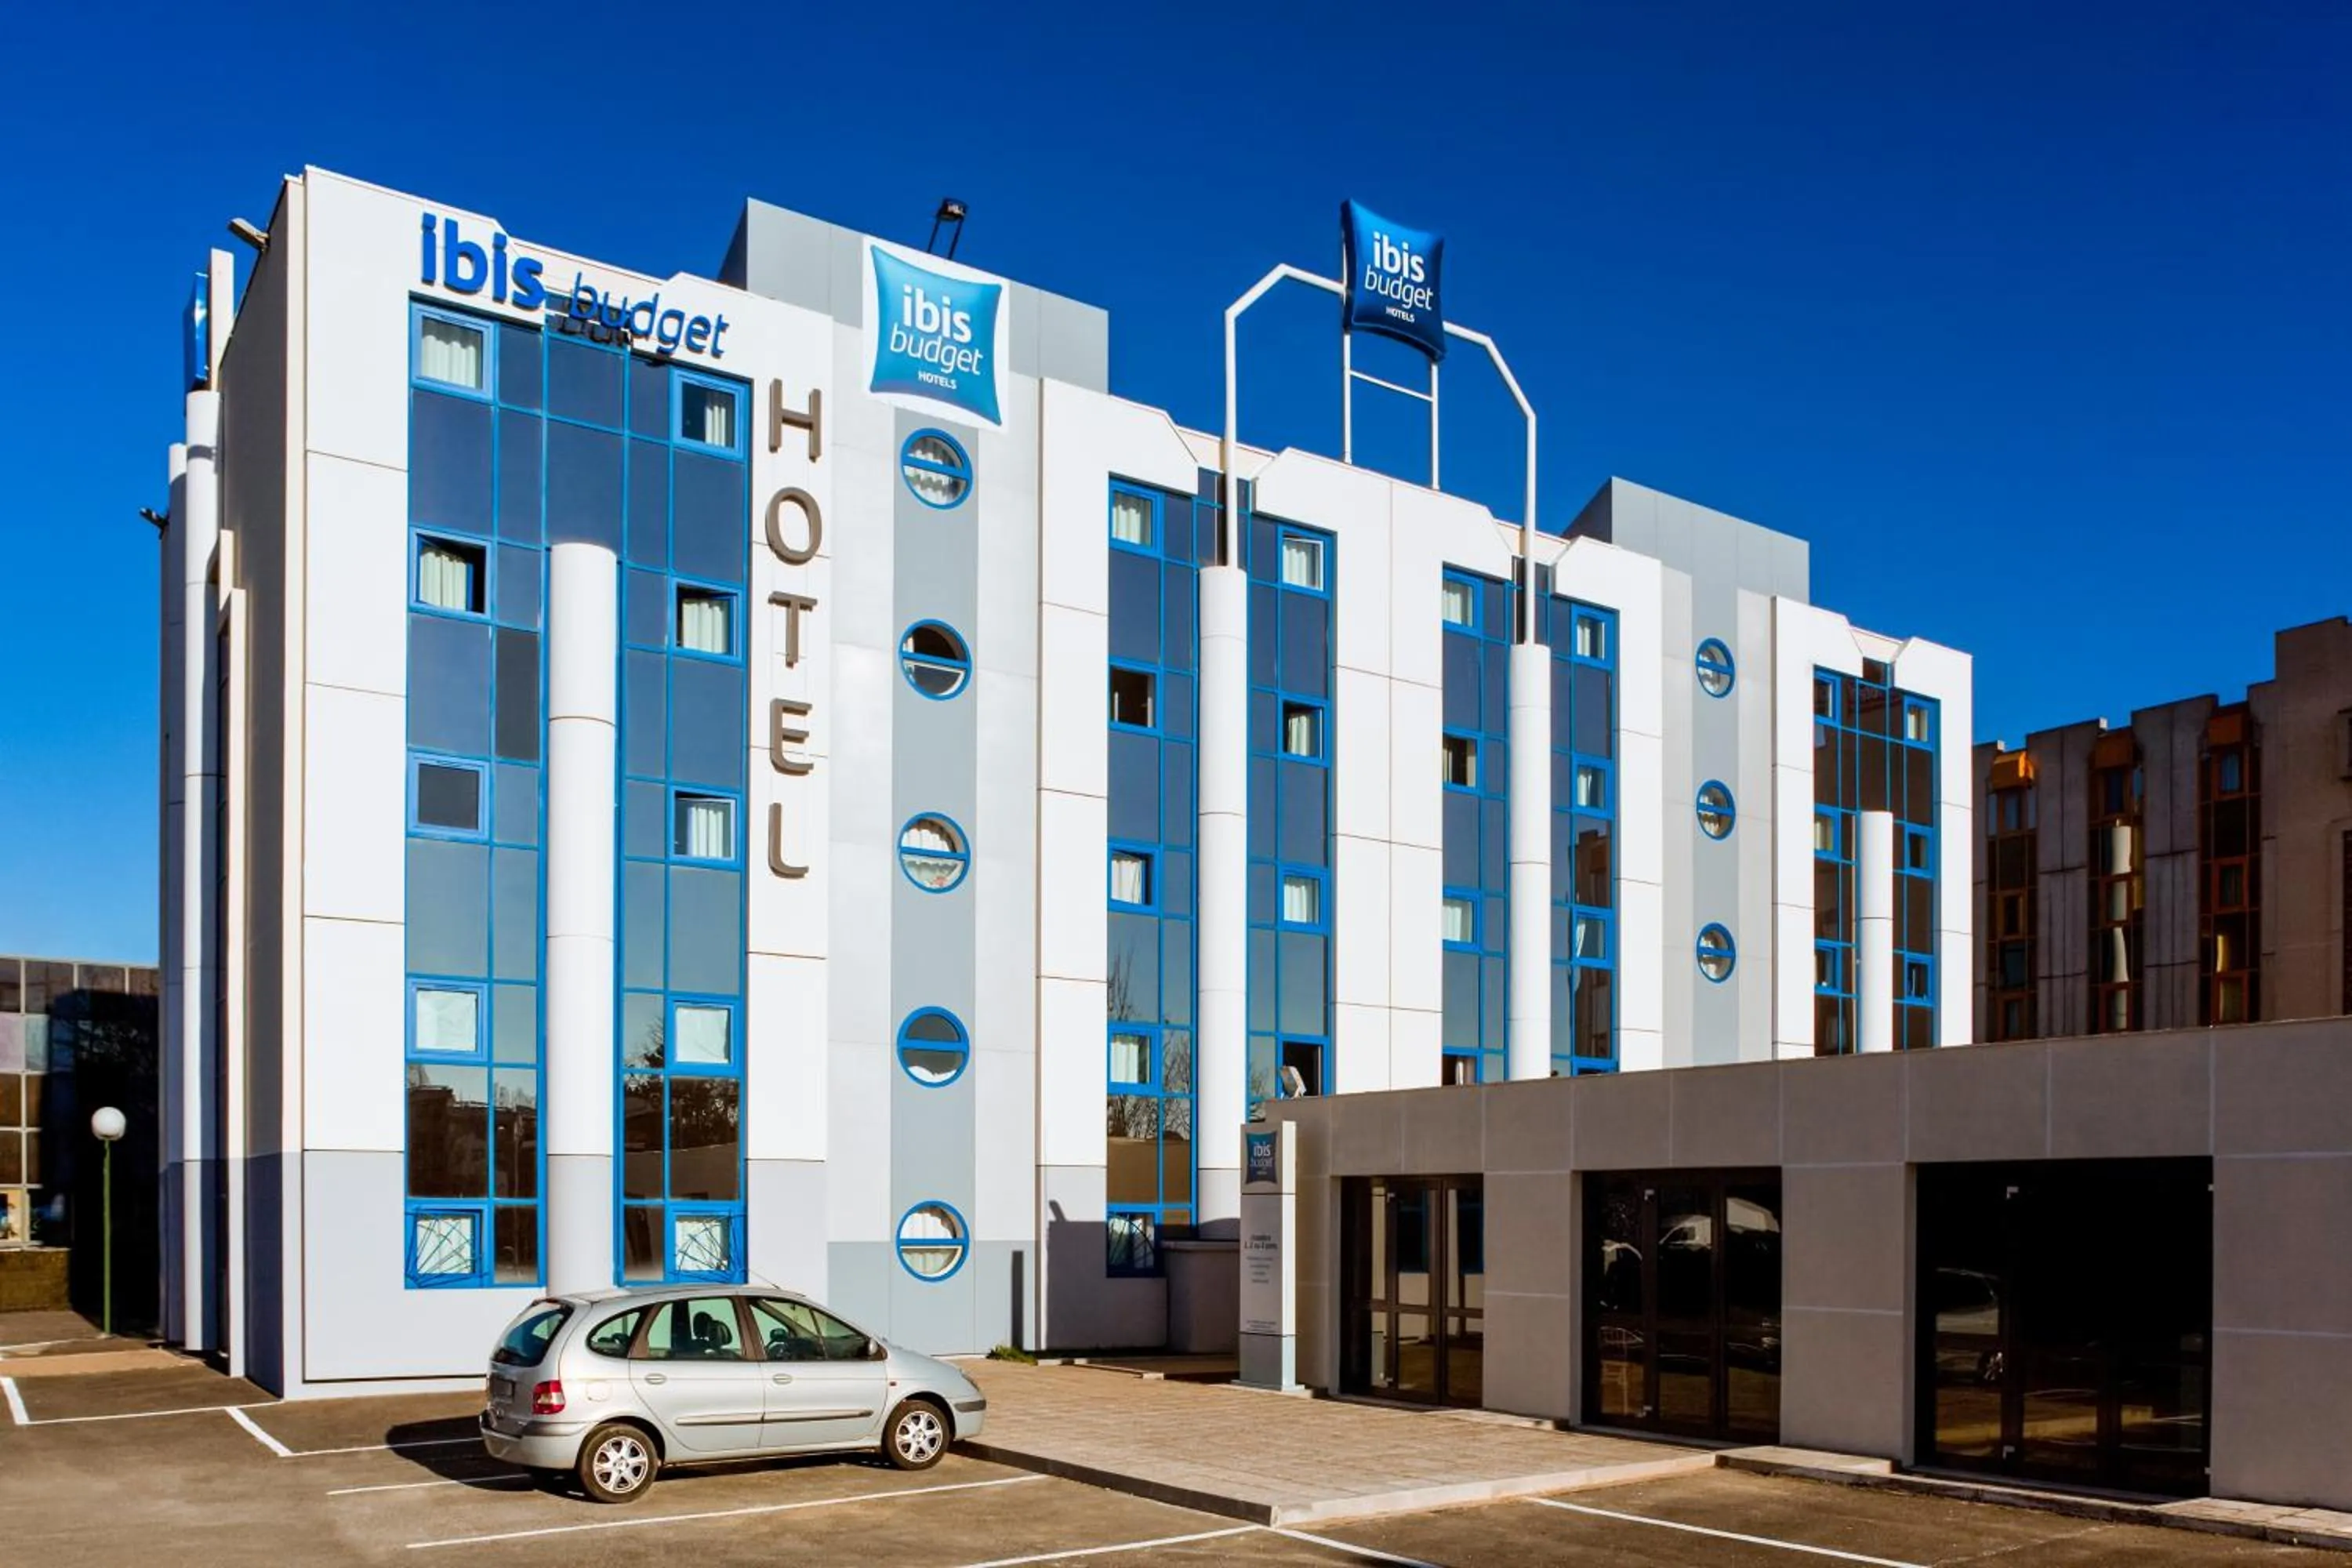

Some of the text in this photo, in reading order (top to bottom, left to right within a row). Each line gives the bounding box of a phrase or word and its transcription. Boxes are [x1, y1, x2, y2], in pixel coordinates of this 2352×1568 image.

[1374, 231, 1425, 283] ibis
[421, 212, 730, 358] ibis budget
[1365, 264, 1434, 311] budget
[903, 284, 971, 343] ibis
[890, 322, 983, 376] budget
[918, 370, 956, 390] HOTELS
[764, 378, 822, 880] HOTEL
